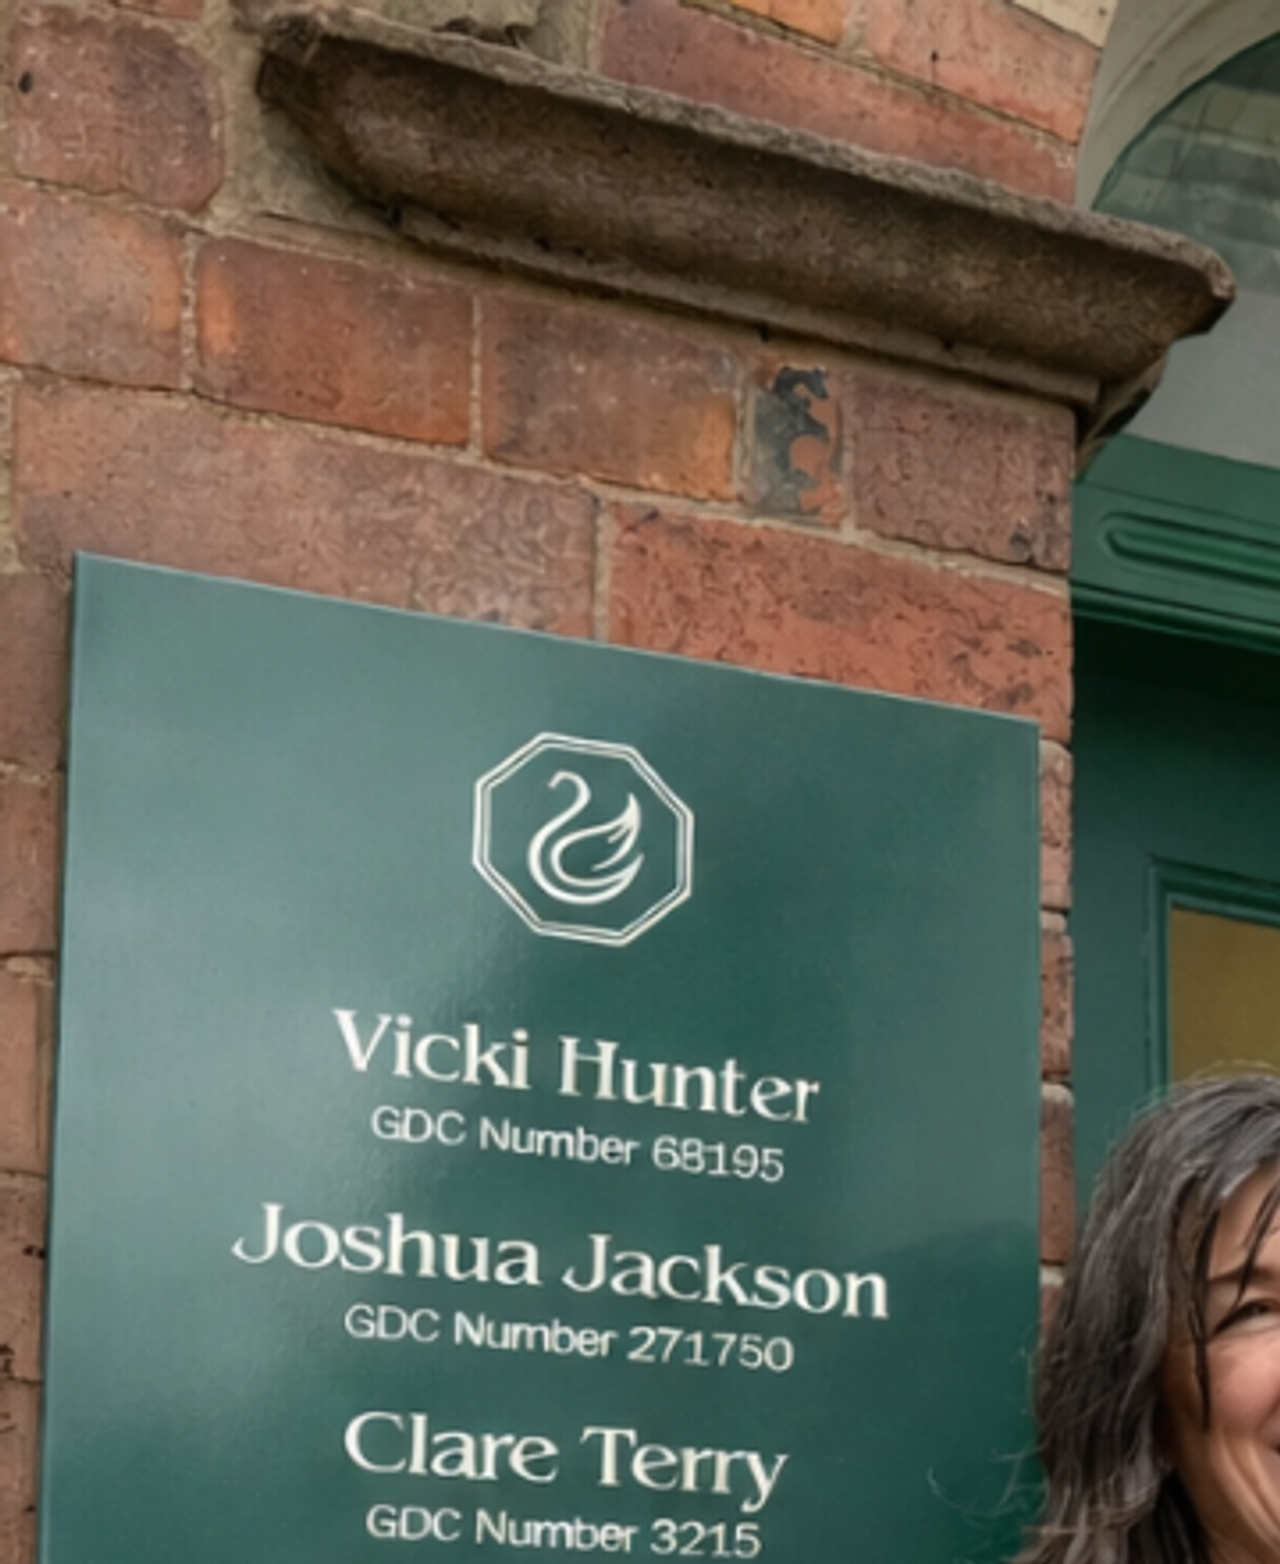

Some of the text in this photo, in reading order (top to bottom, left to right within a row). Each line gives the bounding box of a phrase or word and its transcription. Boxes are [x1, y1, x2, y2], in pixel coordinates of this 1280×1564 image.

[332, 1008, 821, 1124] Vicki Hunter
[370, 1105, 785, 1184] GDC Number 68195
[230, 1202, 890, 1321] Joshua Jackson
[344, 1303, 795, 1373] GDC Number 271750
[343, 1410, 790, 1514] Clare Terry
[365, 1503, 763, 1560] GDC Number 3215
